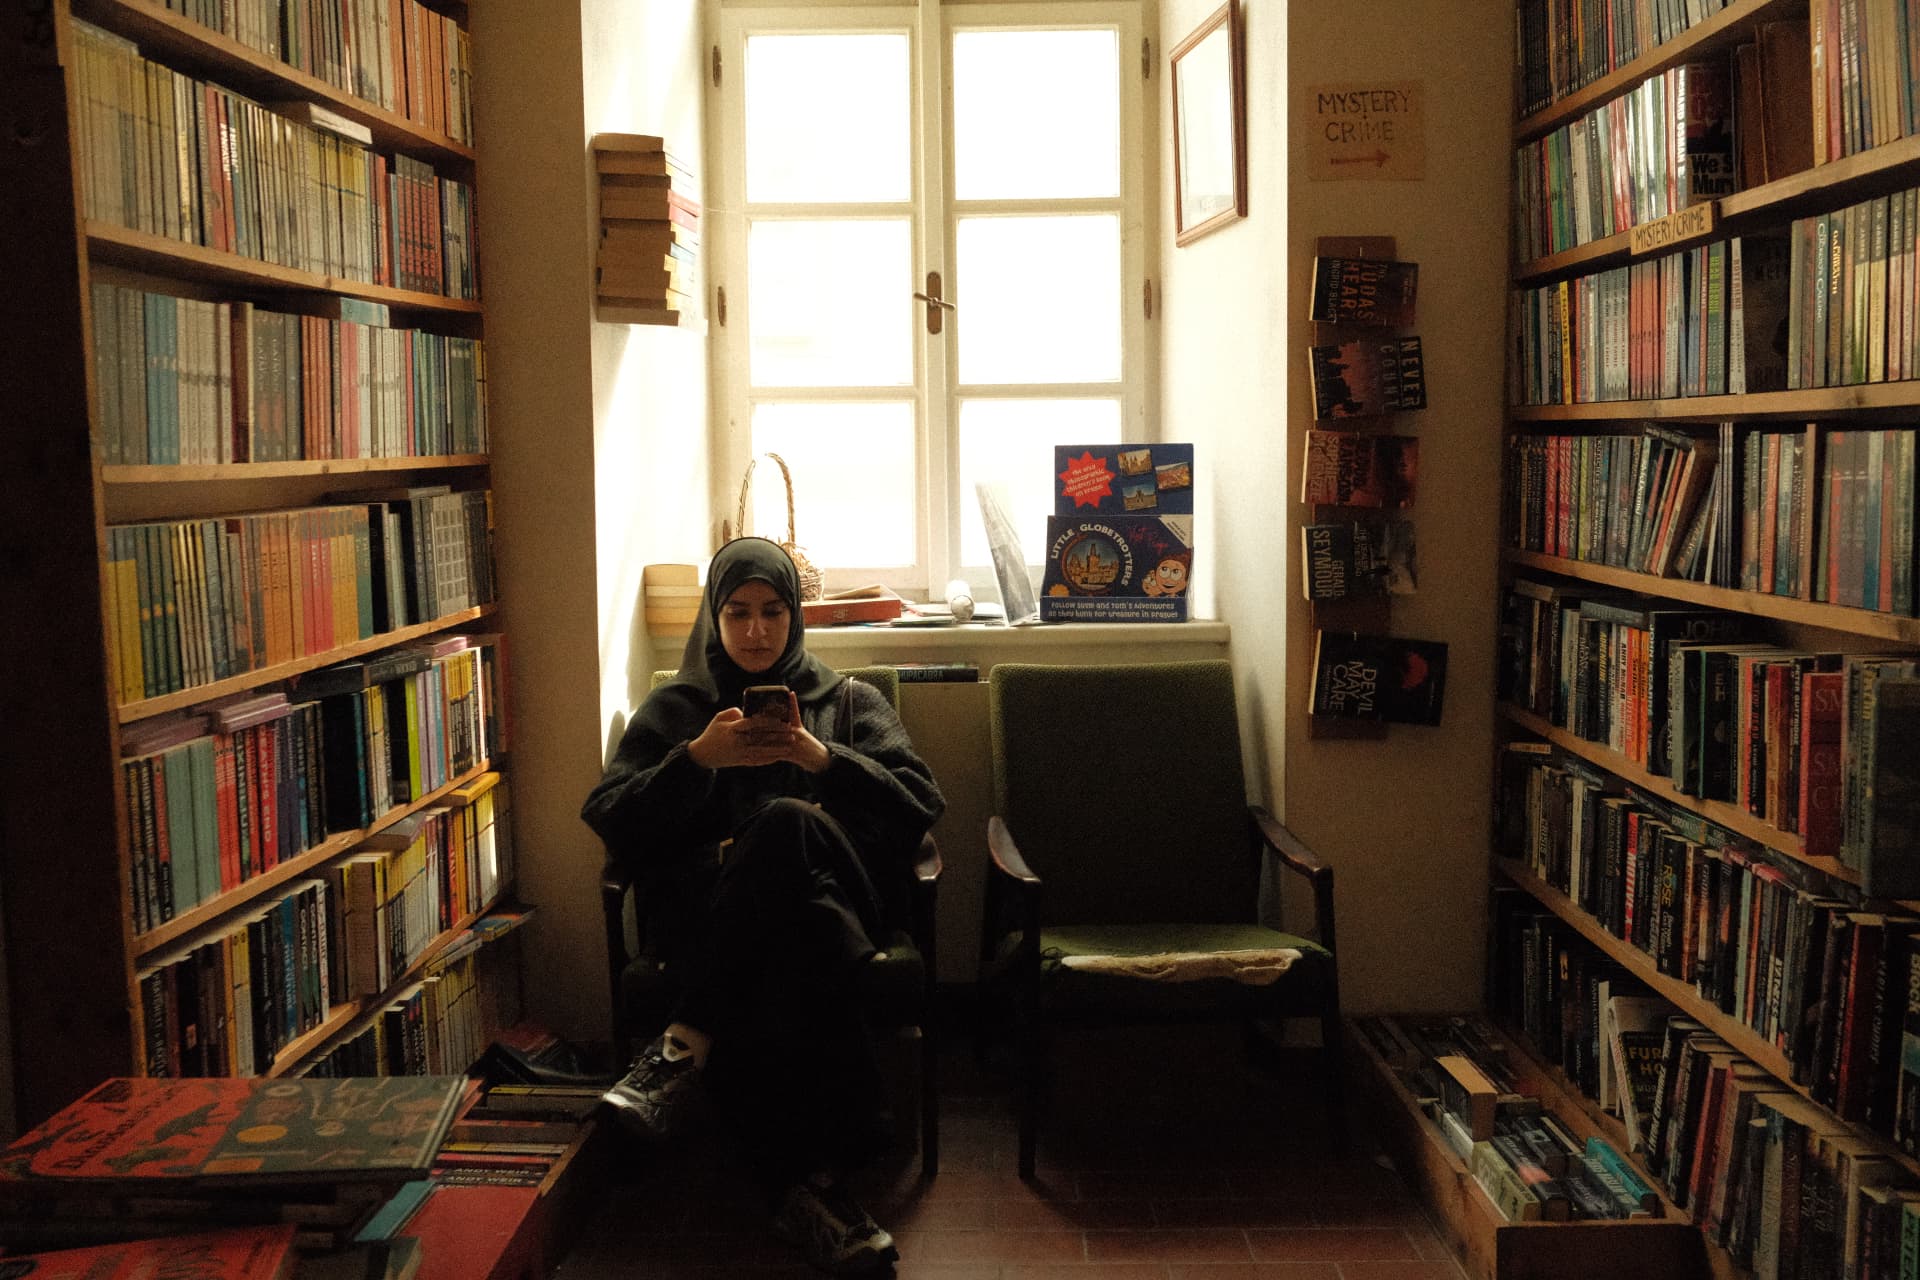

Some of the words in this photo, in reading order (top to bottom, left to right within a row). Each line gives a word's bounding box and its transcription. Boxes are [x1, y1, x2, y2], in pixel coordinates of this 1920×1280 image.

[1317, 89, 1412, 114] MYSTERY
[1325, 121, 1395, 144] CRIME
[1676, 121, 1686, 163] OSMAN
[1692, 154, 1718, 174] We
[1692, 175, 1733, 195] Mur
[1356, 263, 1378, 320] JUDAS
[1400, 338, 1421, 408] NEVER
[1051, 529, 1075, 559] LITTLE
[1080, 524, 1133, 586] GLOBETROTTERS
[1312, 529, 1334, 598] SEYMOUR
[1333, 559, 1345, 598] GERALD
[1648, 623, 1656, 658] JOHN
[1329, 663, 1348, 712] CARE
[1346, 660, 1364, 699] MAY
[1357, 667, 1377, 716] DEVIL
[1793, 664, 1801, 692] PETER
[263, 805, 272, 843] END
[1625, 851, 1637, 911] MOTIVE
[1661, 863, 1674, 908] ROSE
[1628, 1047, 1662, 1058] FUR
